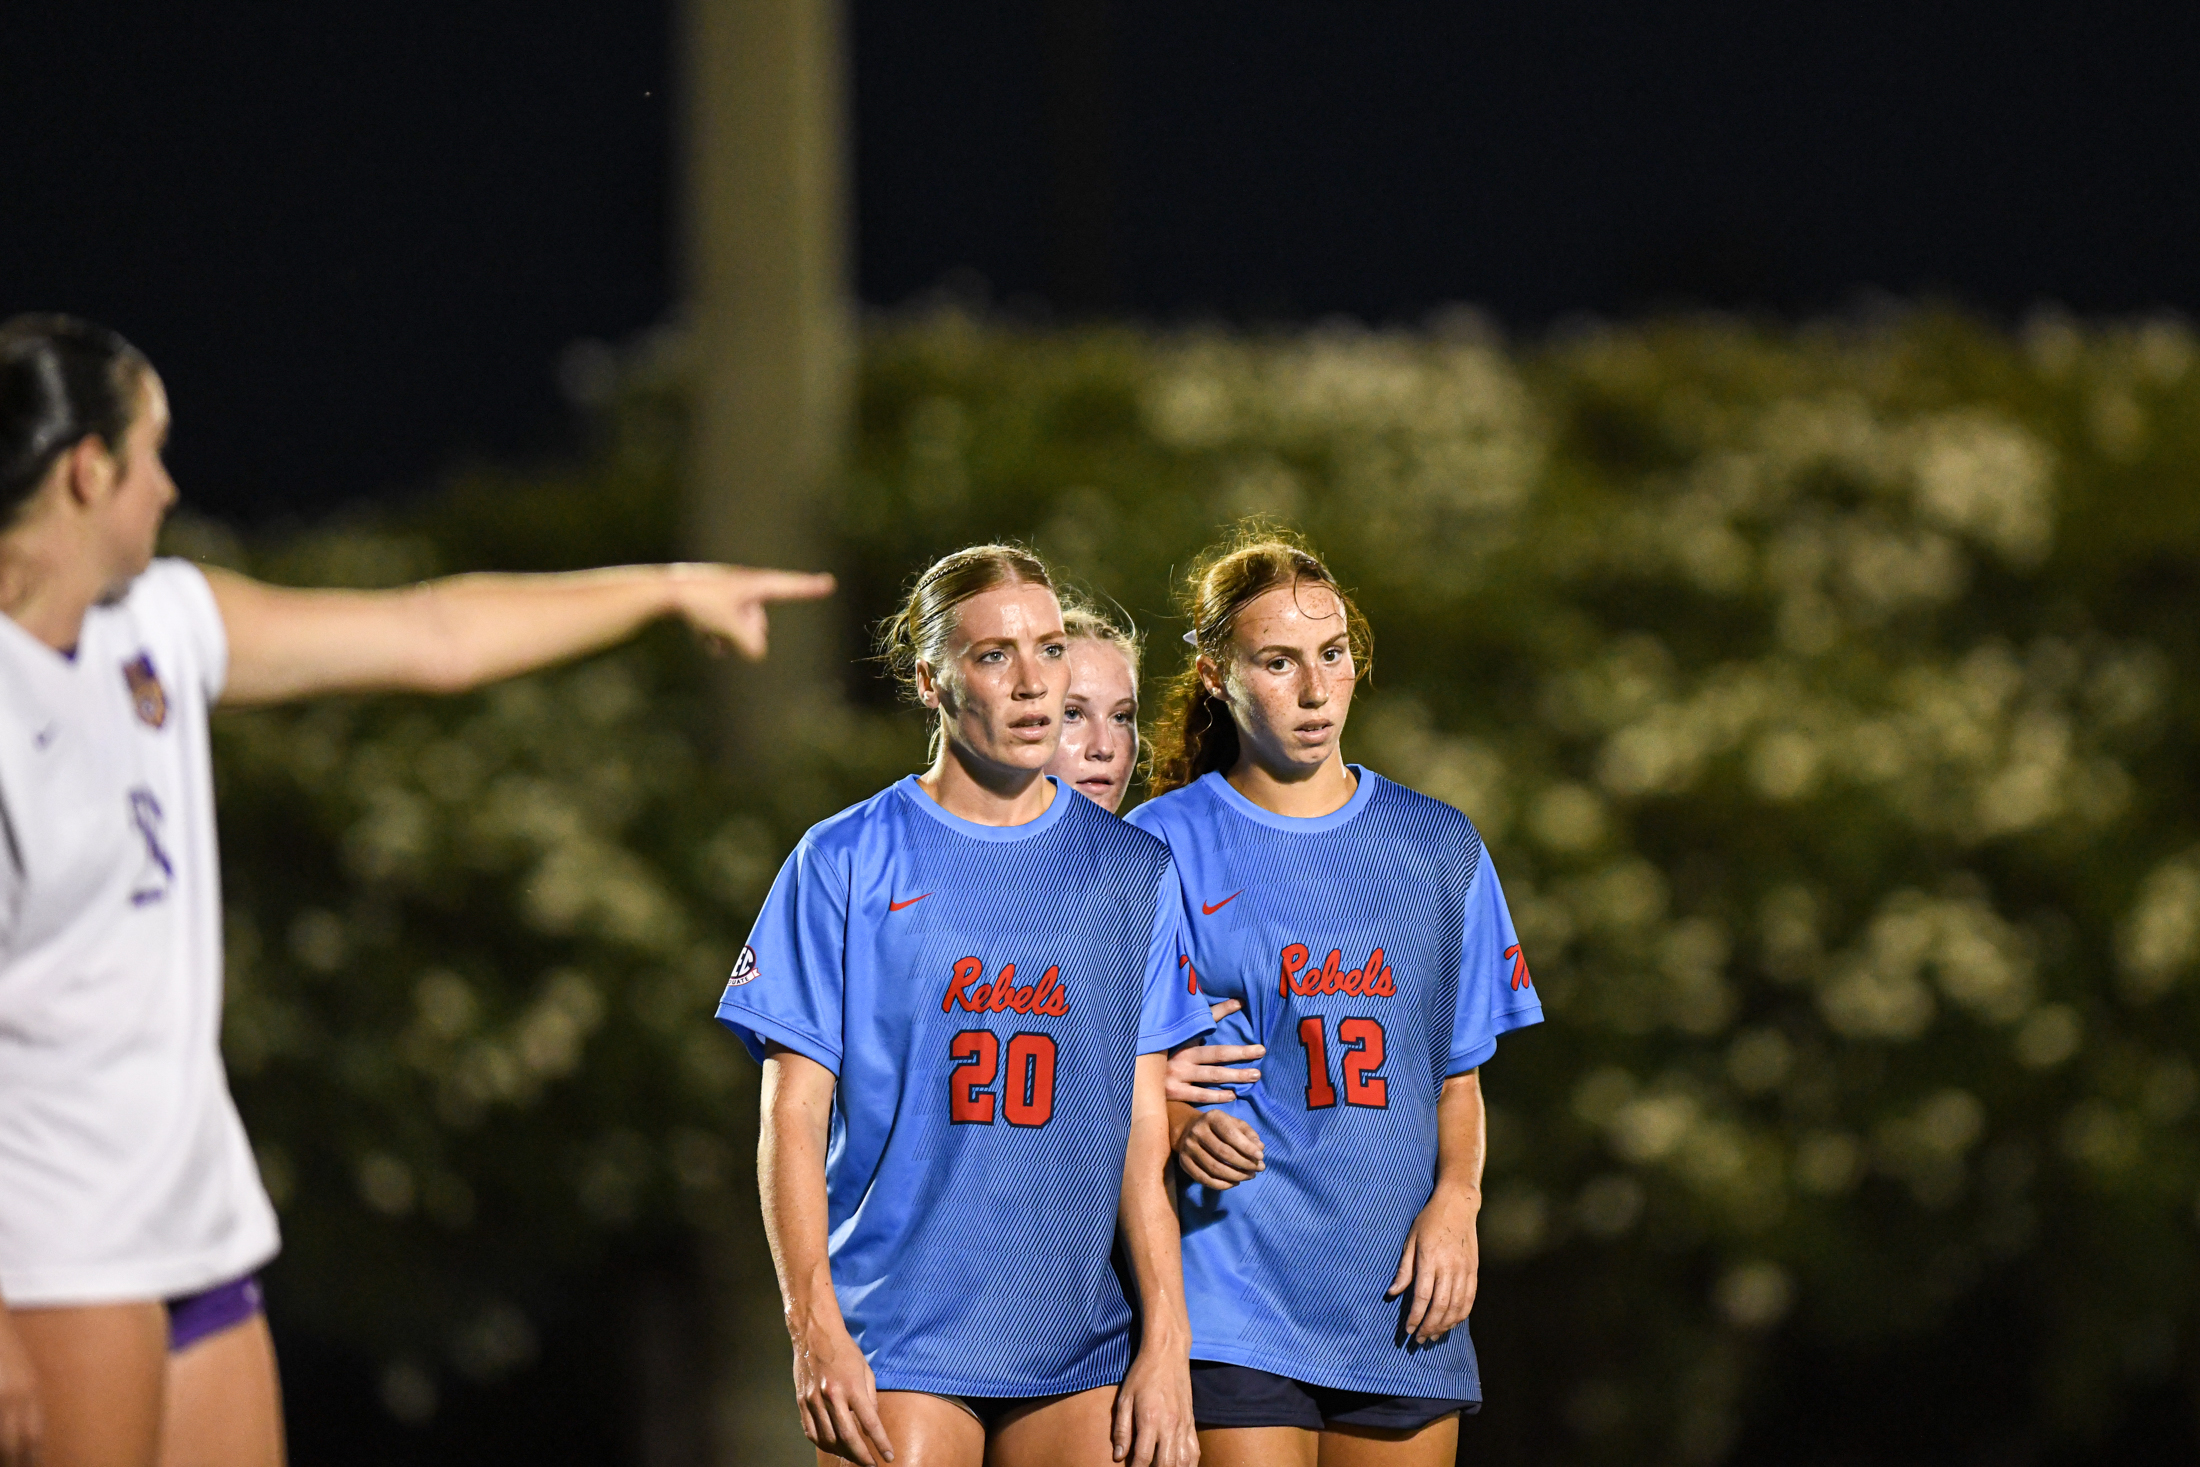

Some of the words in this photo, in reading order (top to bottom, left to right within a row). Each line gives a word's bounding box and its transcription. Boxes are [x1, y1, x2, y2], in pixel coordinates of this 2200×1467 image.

[942, 956, 1069, 1017] Rebels
[1279, 943, 1397, 998] Rebels
[949, 1029, 1058, 1129] 20
[1297, 1015, 1389, 1111] 12
